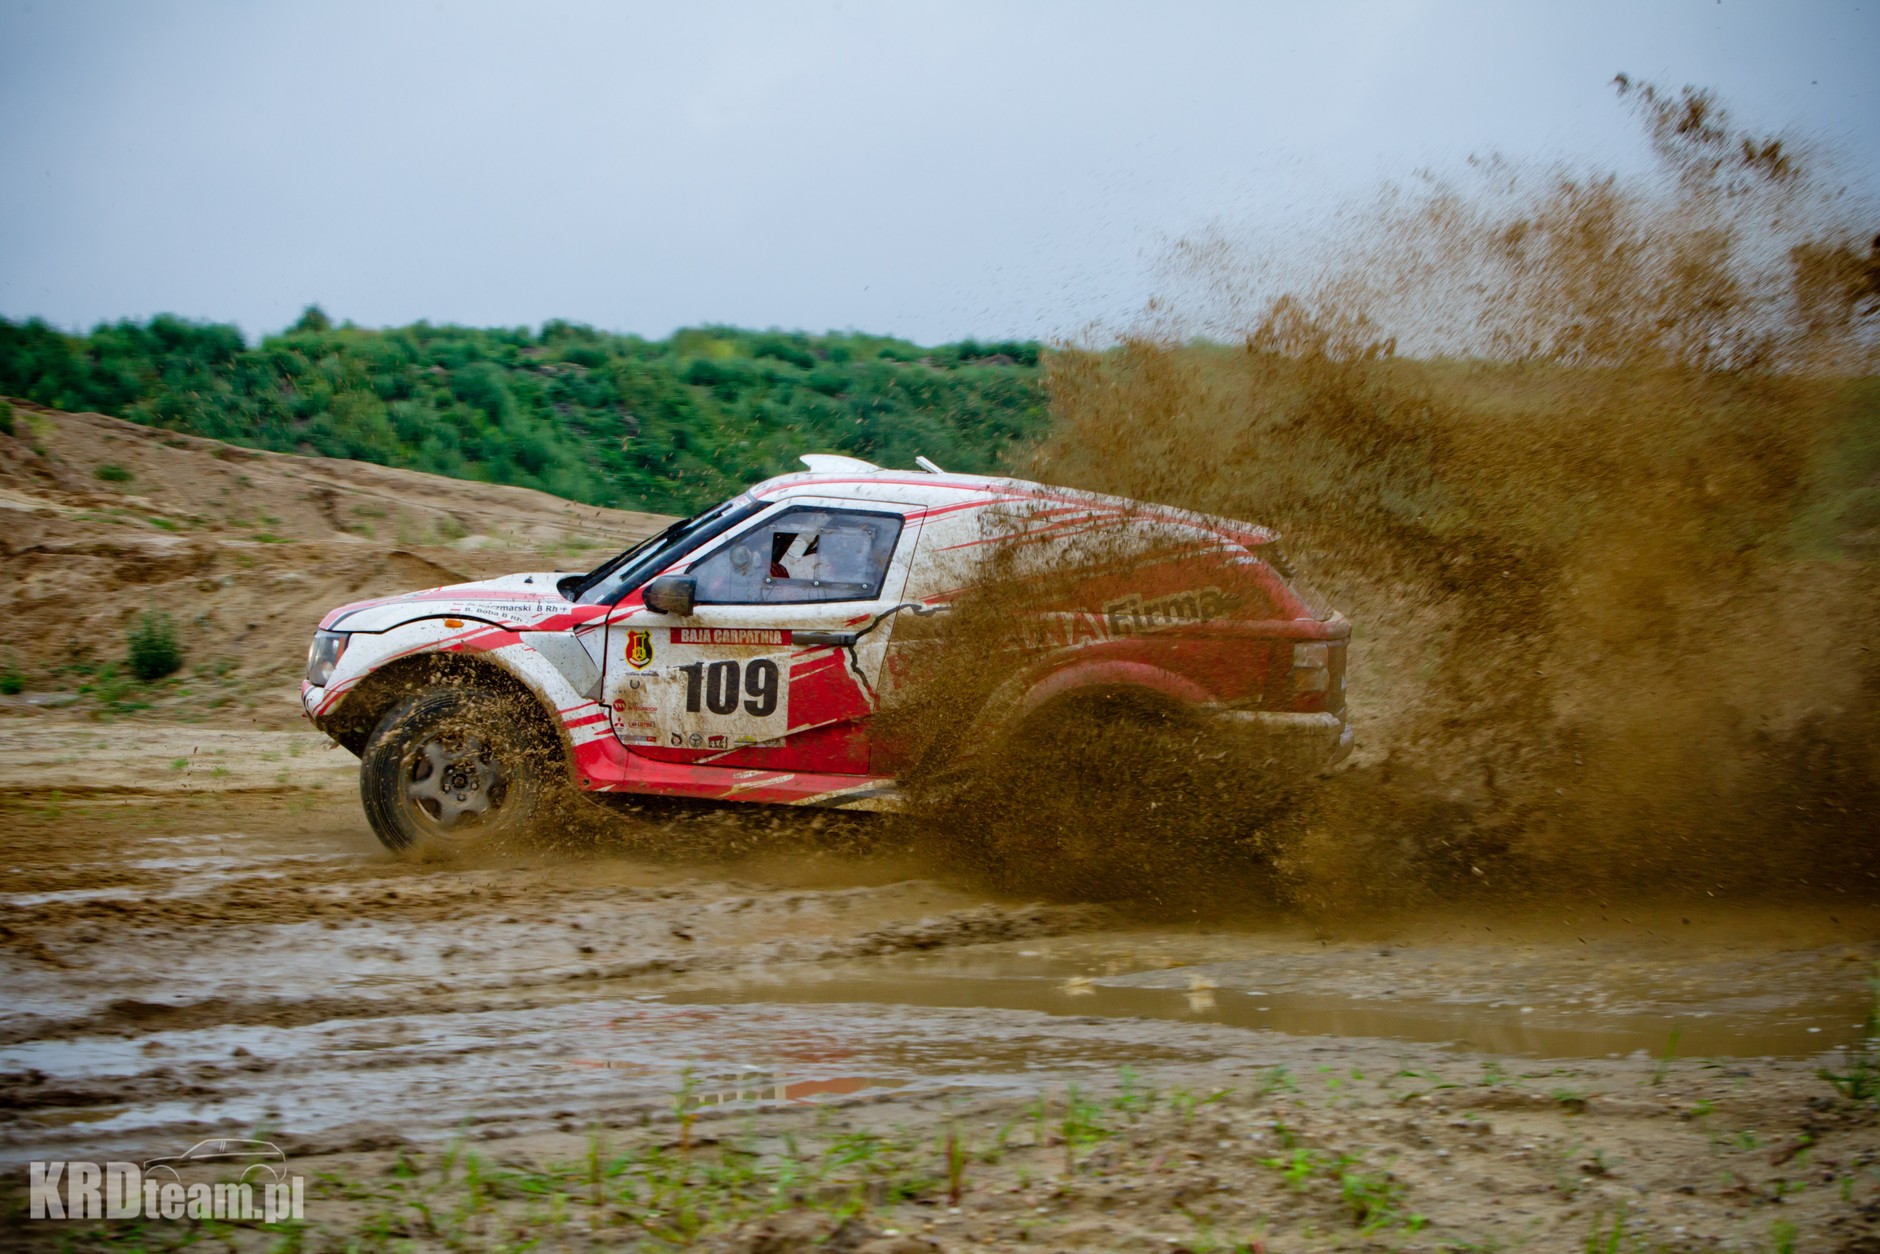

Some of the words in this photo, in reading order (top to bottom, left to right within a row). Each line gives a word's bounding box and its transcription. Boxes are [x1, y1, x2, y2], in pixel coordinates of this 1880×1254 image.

[680, 628, 711, 643] BAJA
[713, 628, 782, 644] CARPATHIA
[678, 658, 779, 717] 109
